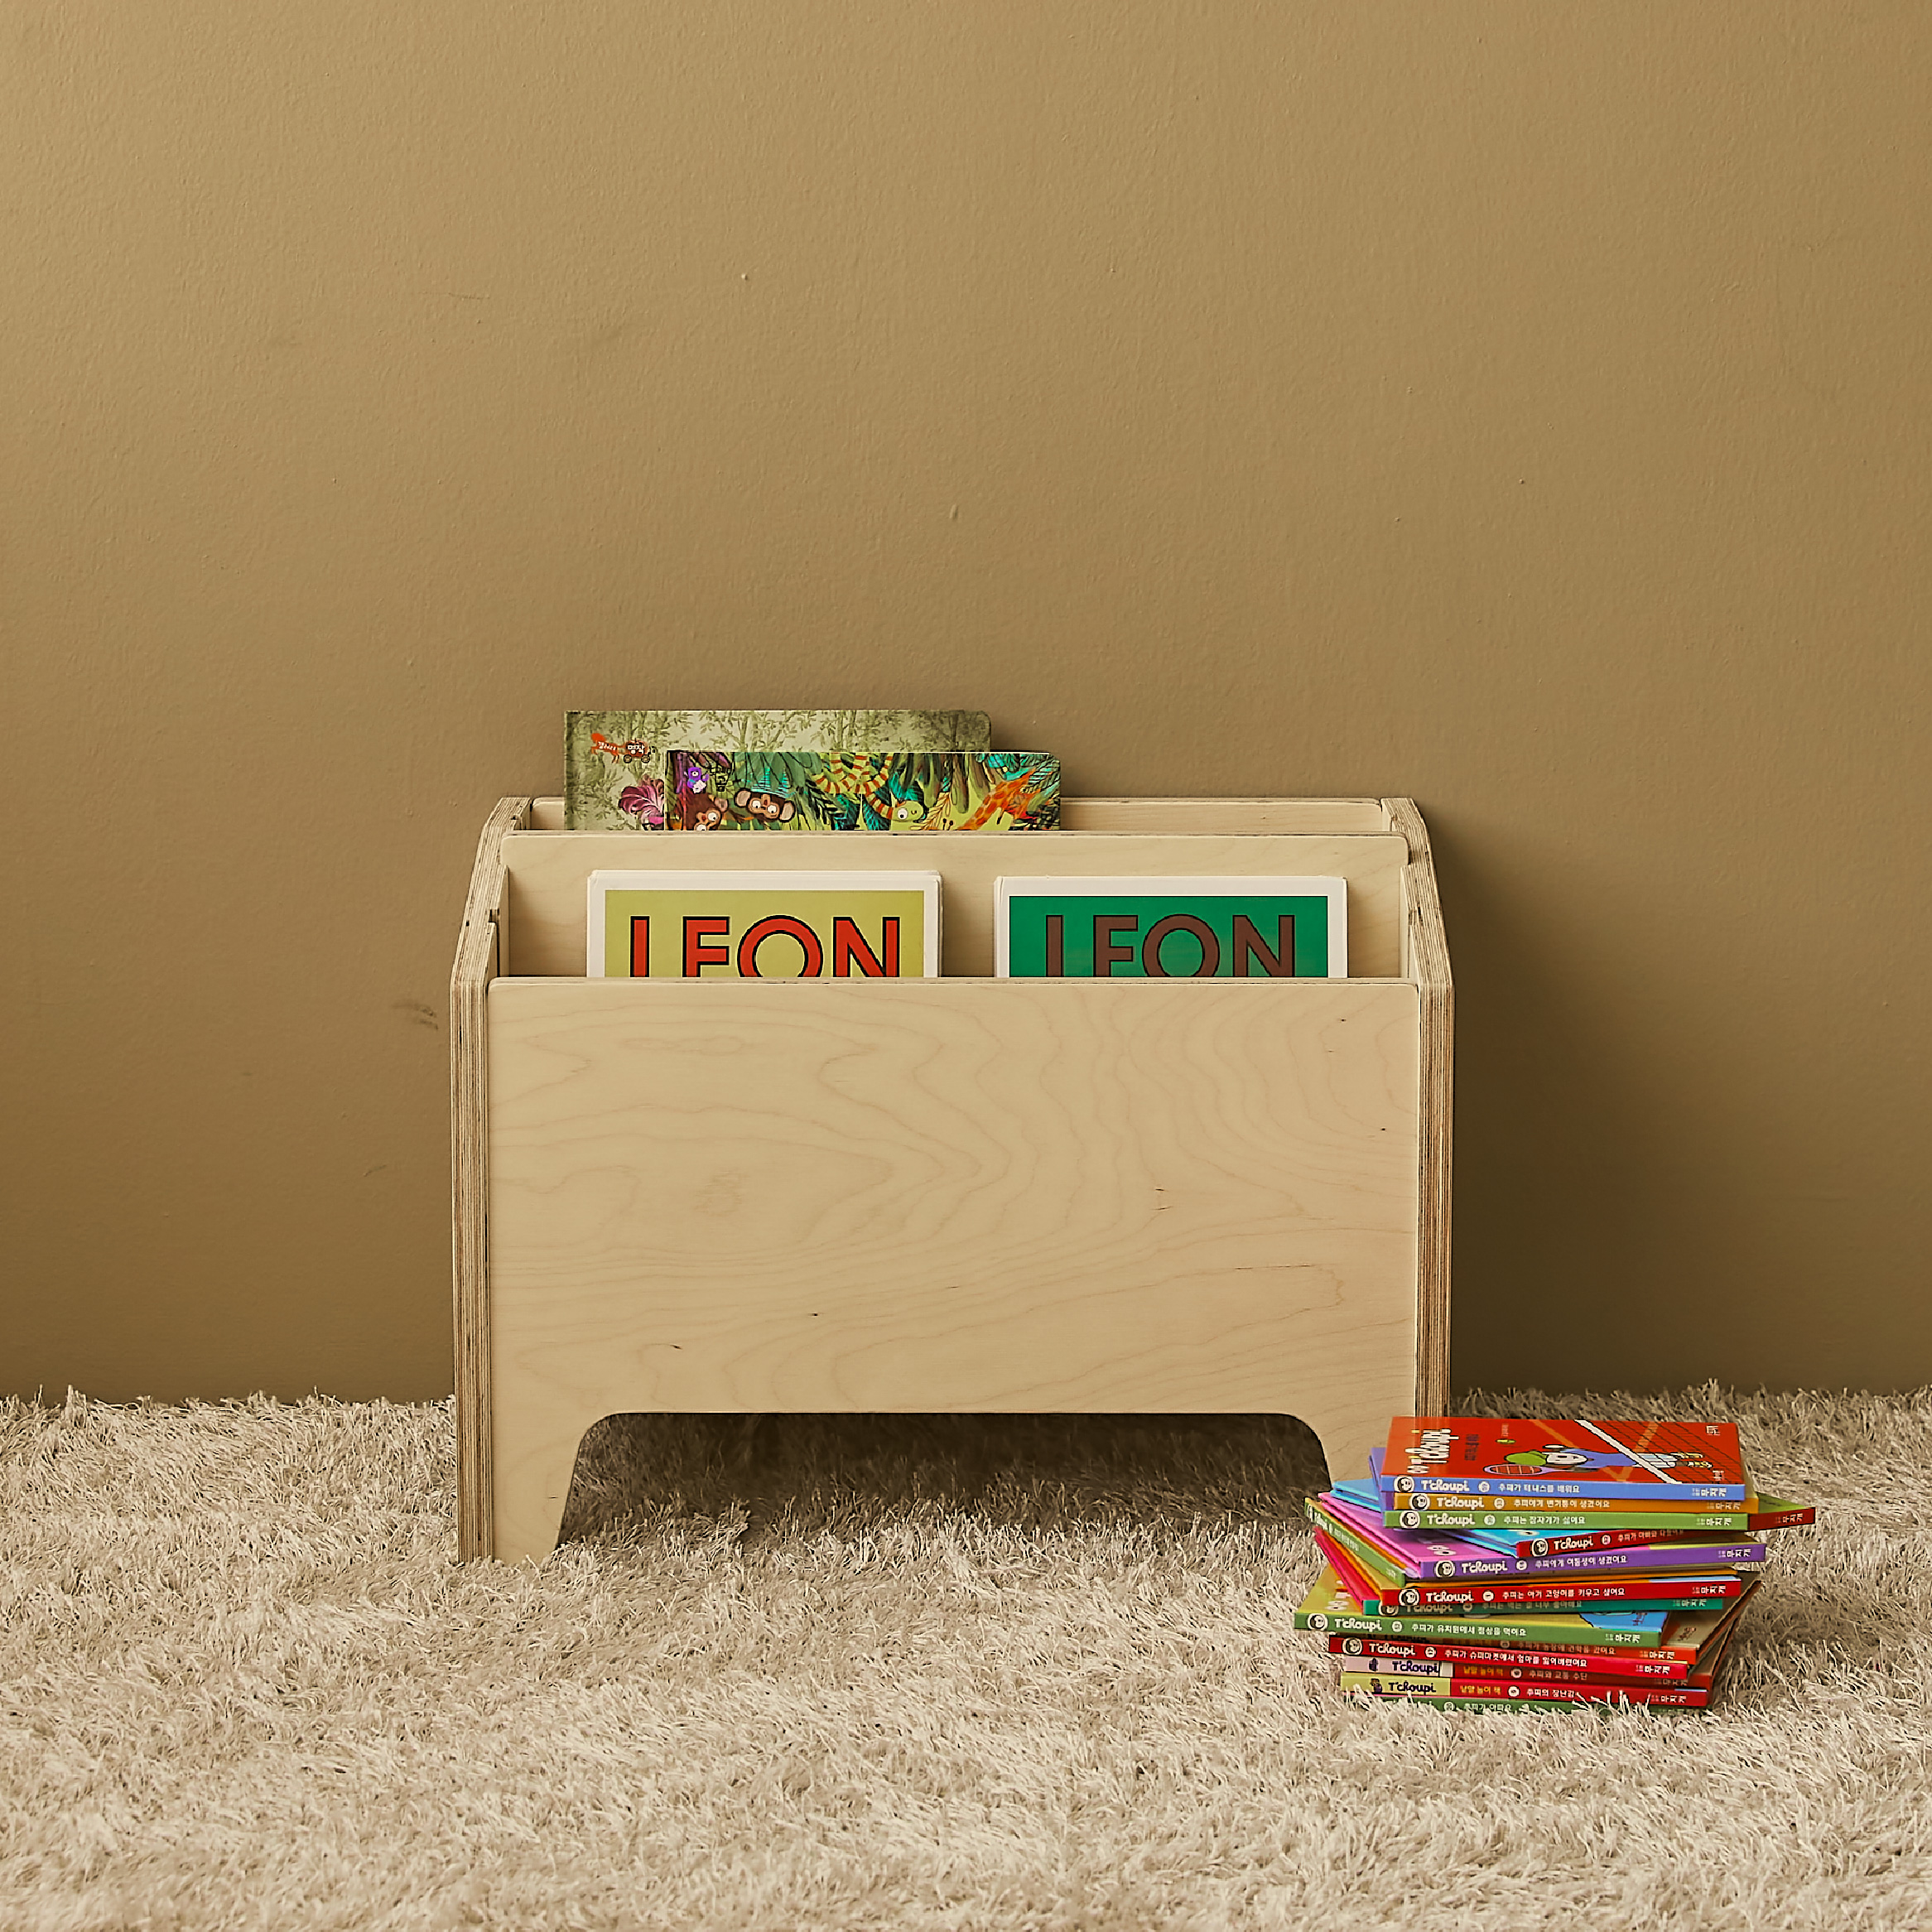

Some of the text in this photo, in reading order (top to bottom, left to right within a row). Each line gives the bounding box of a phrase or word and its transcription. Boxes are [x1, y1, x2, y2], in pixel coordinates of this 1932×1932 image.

[1421, 1479, 1470, 1493] T'choupi
[1499, 1483, 1580, 1493] 추피가 테니스를 배워요
[1437, 1496, 1485, 1510] T'choupi
[1514, 1499, 1544, 1507] 추피에게
[1580, 1501, 1610, 1509] 생겼어요
[1427, 1513, 1475, 1527] T'choupi
[1504, 1515, 1527, 1525] 추피는
[1554, 1535, 1593, 1550] T'choupi
[1618, 1532, 1636, 1542] 추피가
[1462, 1561, 1508, 1575] T'choupi
[1535, 1555, 1627, 1568] 추피에게 여동생이 생겼어요
[1426, 1591, 1474, 1603] T'choupi
[1502, 1591, 1525, 1600] 추피는
[1527, 1590, 1542, 1599] 아기
[1545, 1589, 1574, 1599] 고양이를
[1578, 1588, 1600, 1597] 키우고
[1334, 1617, 1382, 1632] T'choupi
[1411, 1623, 1526, 1636] 추피가 유치원에서 점심을 먹어요
[1369, 1643, 1416, 1658] T'choupi
[1444, 1650, 1588, 1668] 추피가 슈퍼마켓에서 엄마를 잃어버렸어요
[1392, 1660, 1439, 1677] T'choupi
[1529, 1669, 1552, 1679] 추피와
[1388, 1682, 1436, 1695] T'choupi
[1459, 1685, 1475, 1694] 낱말
[1477, 1686, 1491, 1694] 놀이
[1526, 1689, 1549, 1698] 추피의
[1552, 1689, 1575, 1698] 장난감
